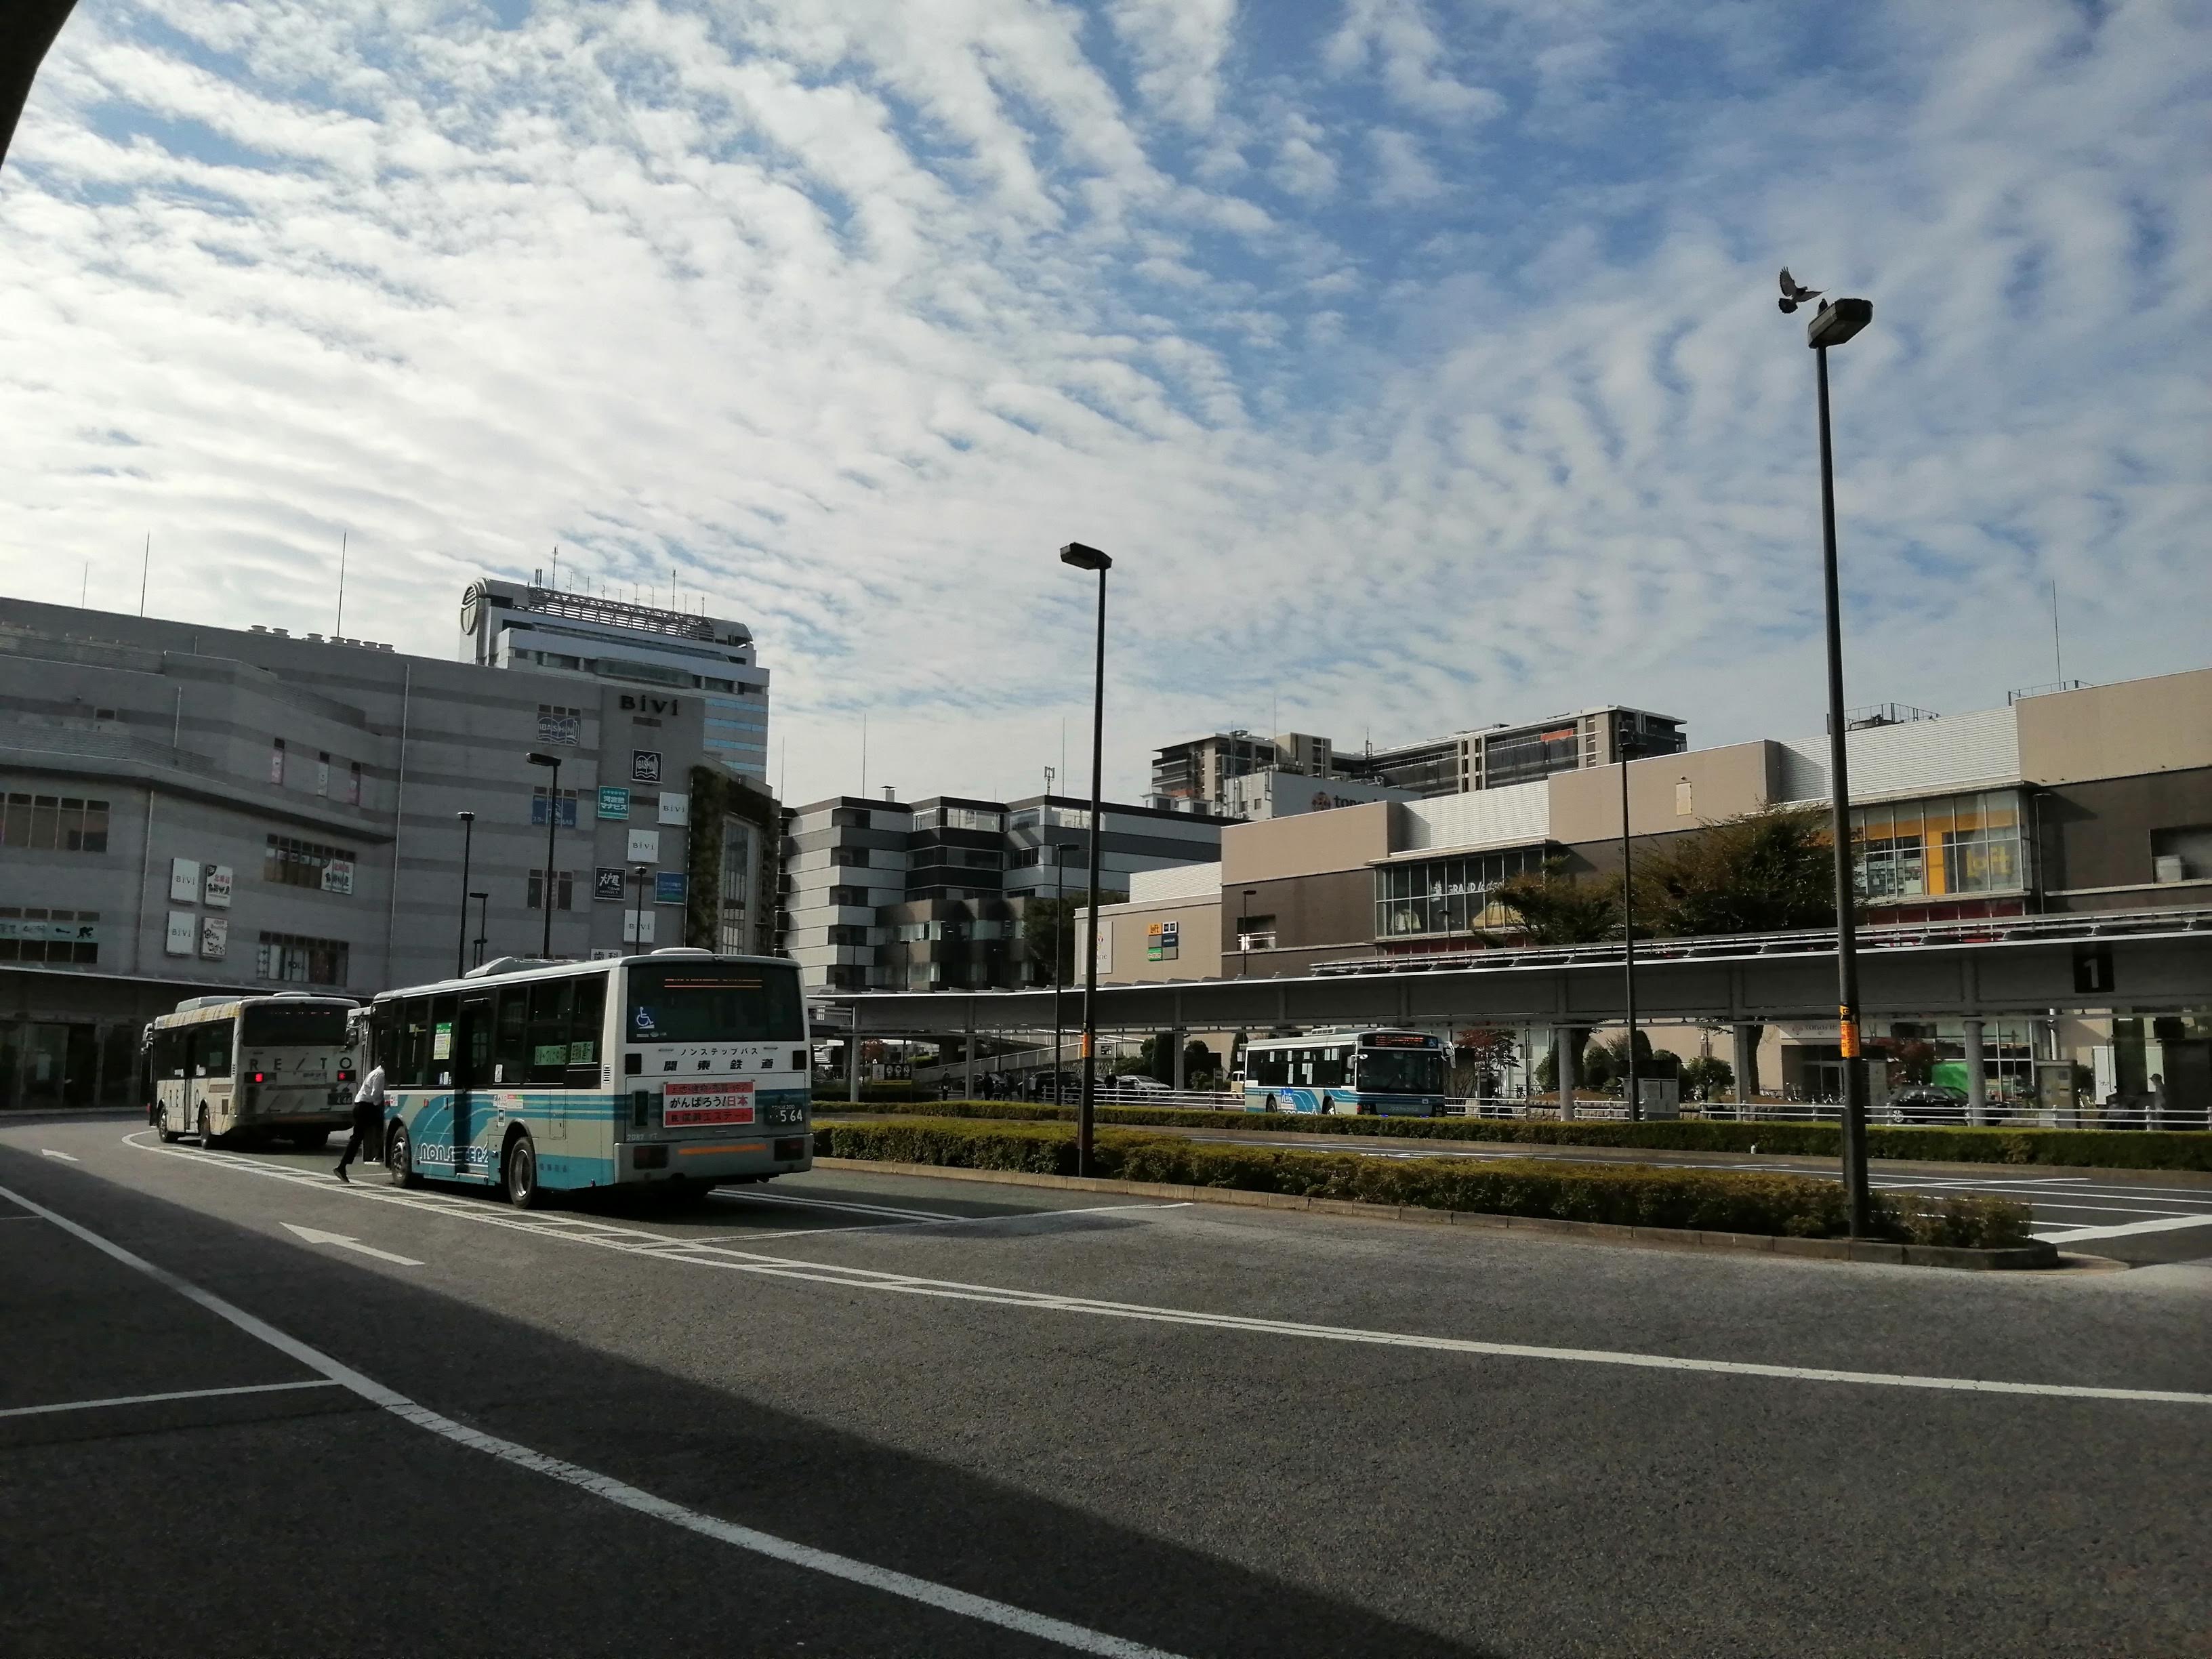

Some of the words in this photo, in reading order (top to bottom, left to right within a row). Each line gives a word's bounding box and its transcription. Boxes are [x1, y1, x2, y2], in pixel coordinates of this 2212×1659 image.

[2083, 958, 2100, 988] 1
[680, 1048, 758, 1056] ノンステップバス
